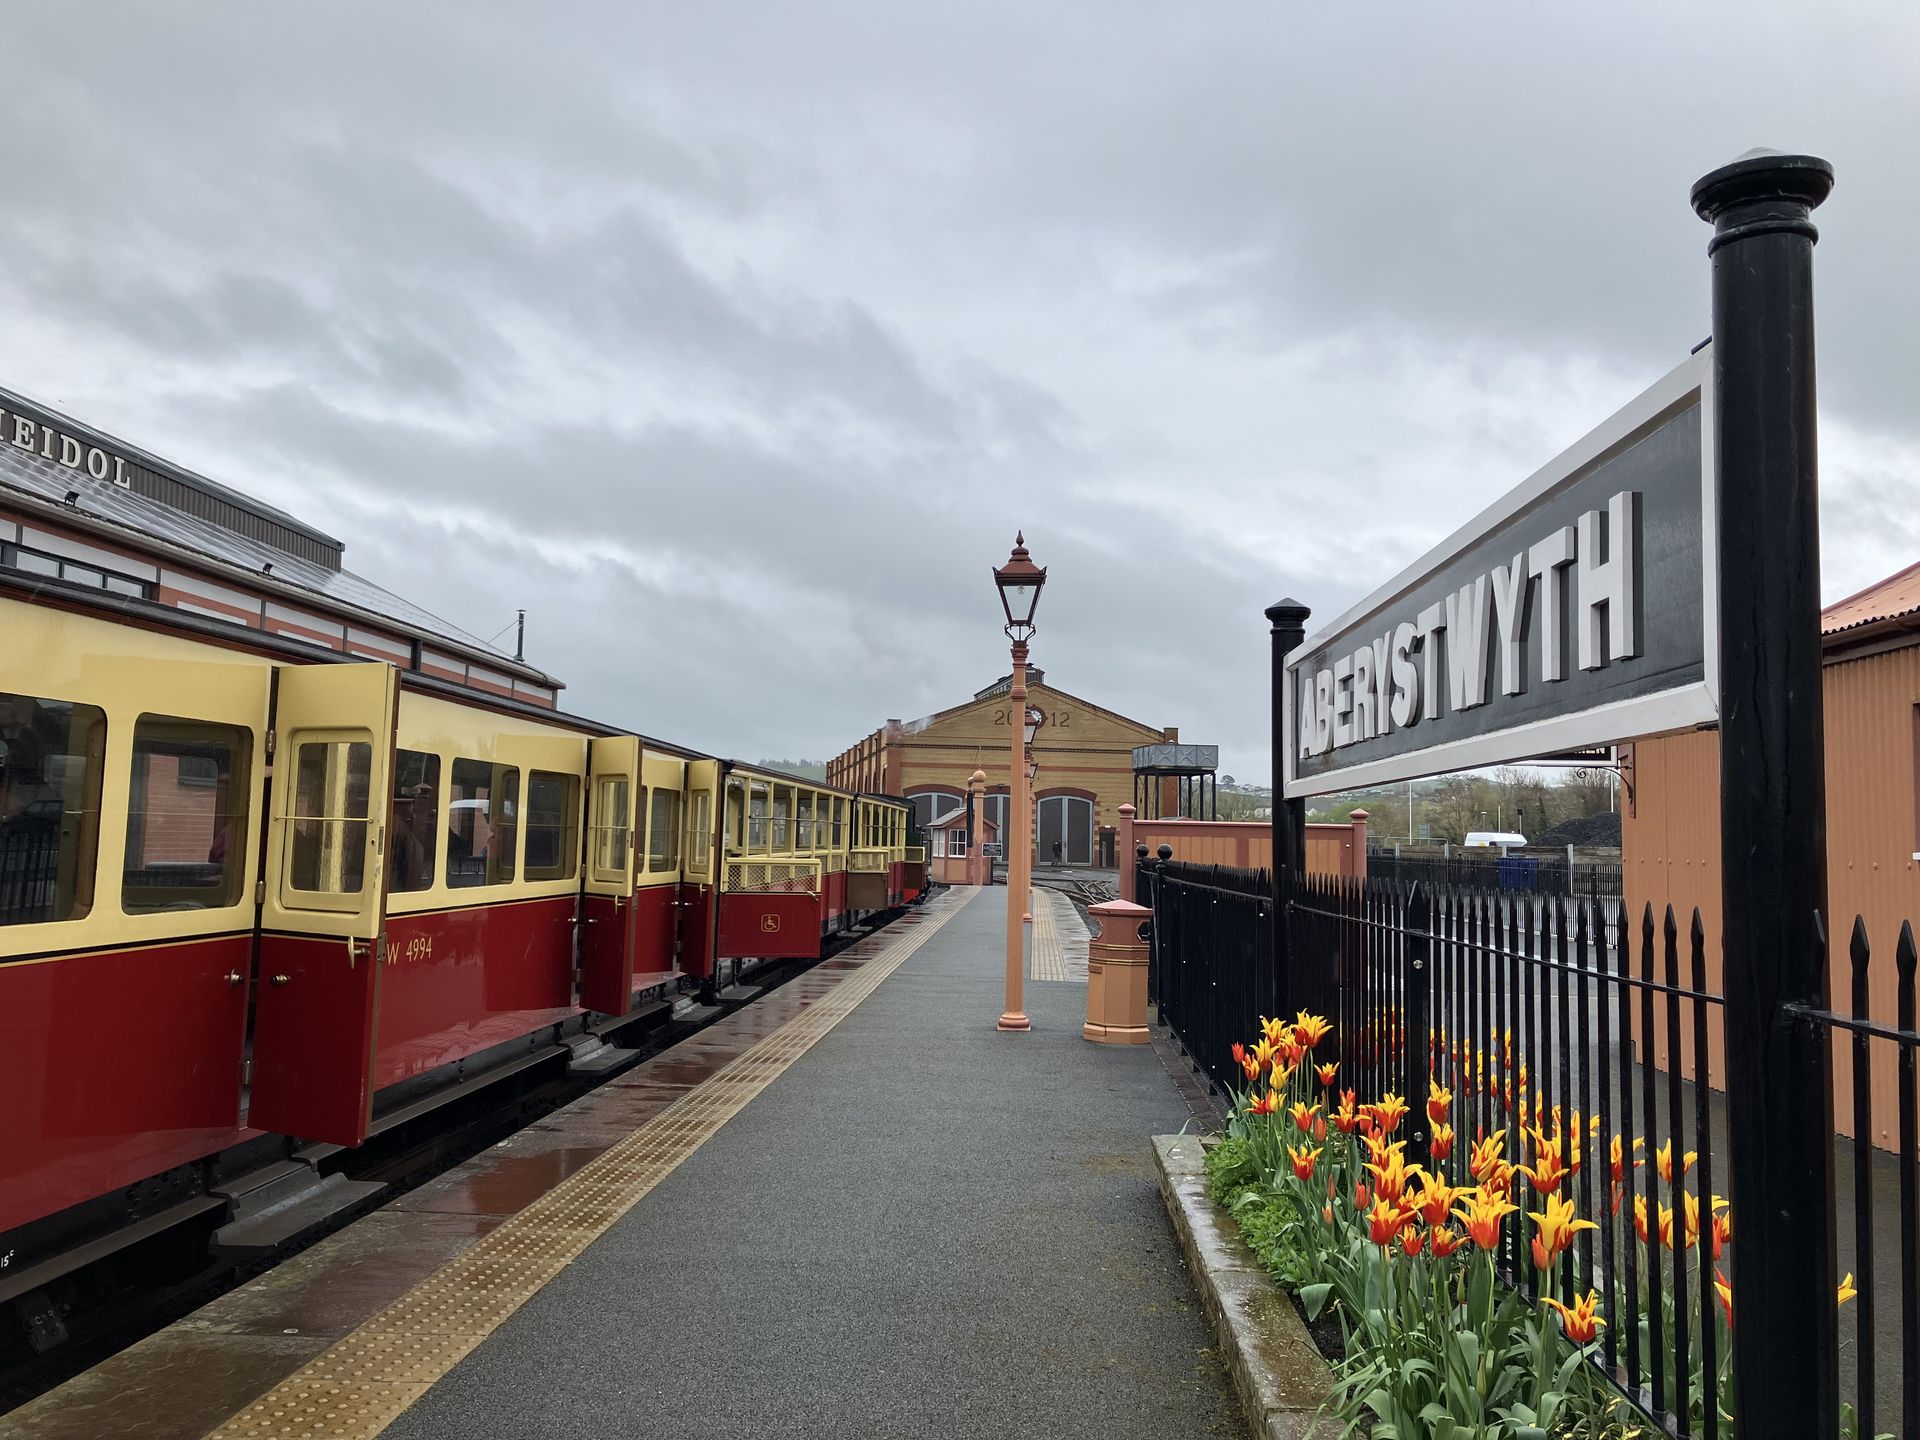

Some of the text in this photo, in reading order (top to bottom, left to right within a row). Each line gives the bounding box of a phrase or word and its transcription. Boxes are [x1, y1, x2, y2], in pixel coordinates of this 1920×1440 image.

[0, 409, 130, 489] EIDOL
[1300, 491, 1634, 758] ABERYSTWYTH
[1051, 711, 1070, 728] 12
[386, 936, 432, 965] W 4994
